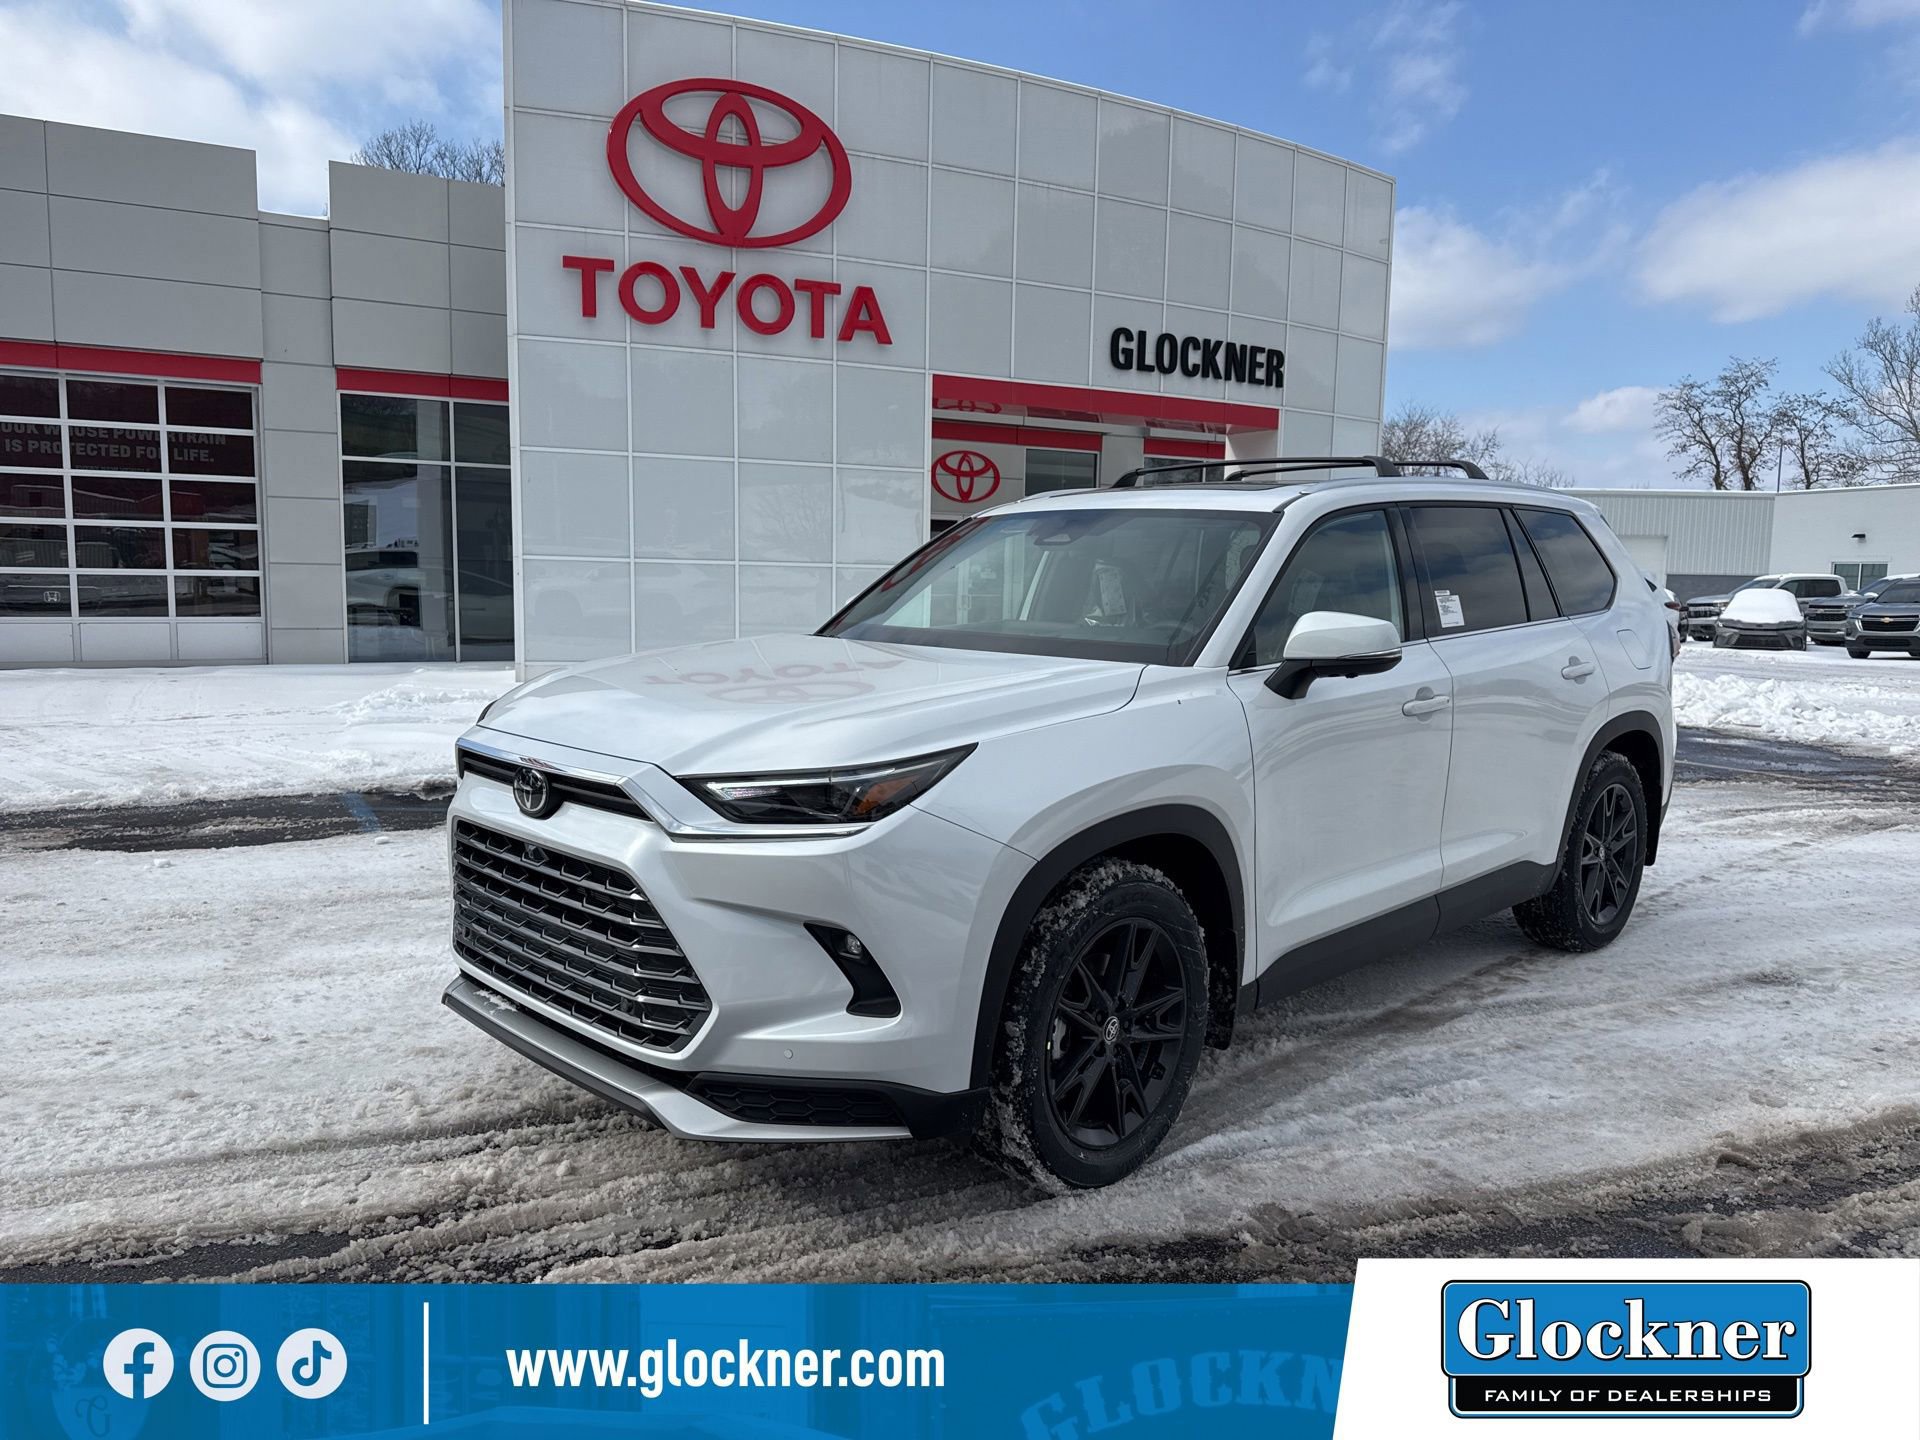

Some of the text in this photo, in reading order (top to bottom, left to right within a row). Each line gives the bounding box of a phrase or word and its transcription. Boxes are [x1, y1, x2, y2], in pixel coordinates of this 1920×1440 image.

[562, 254, 893, 346] TOYOTA
[1110, 326, 1286, 390] GLOCKNER
[5, 439, 215, 462] IS PROECTED FO LIFE.
